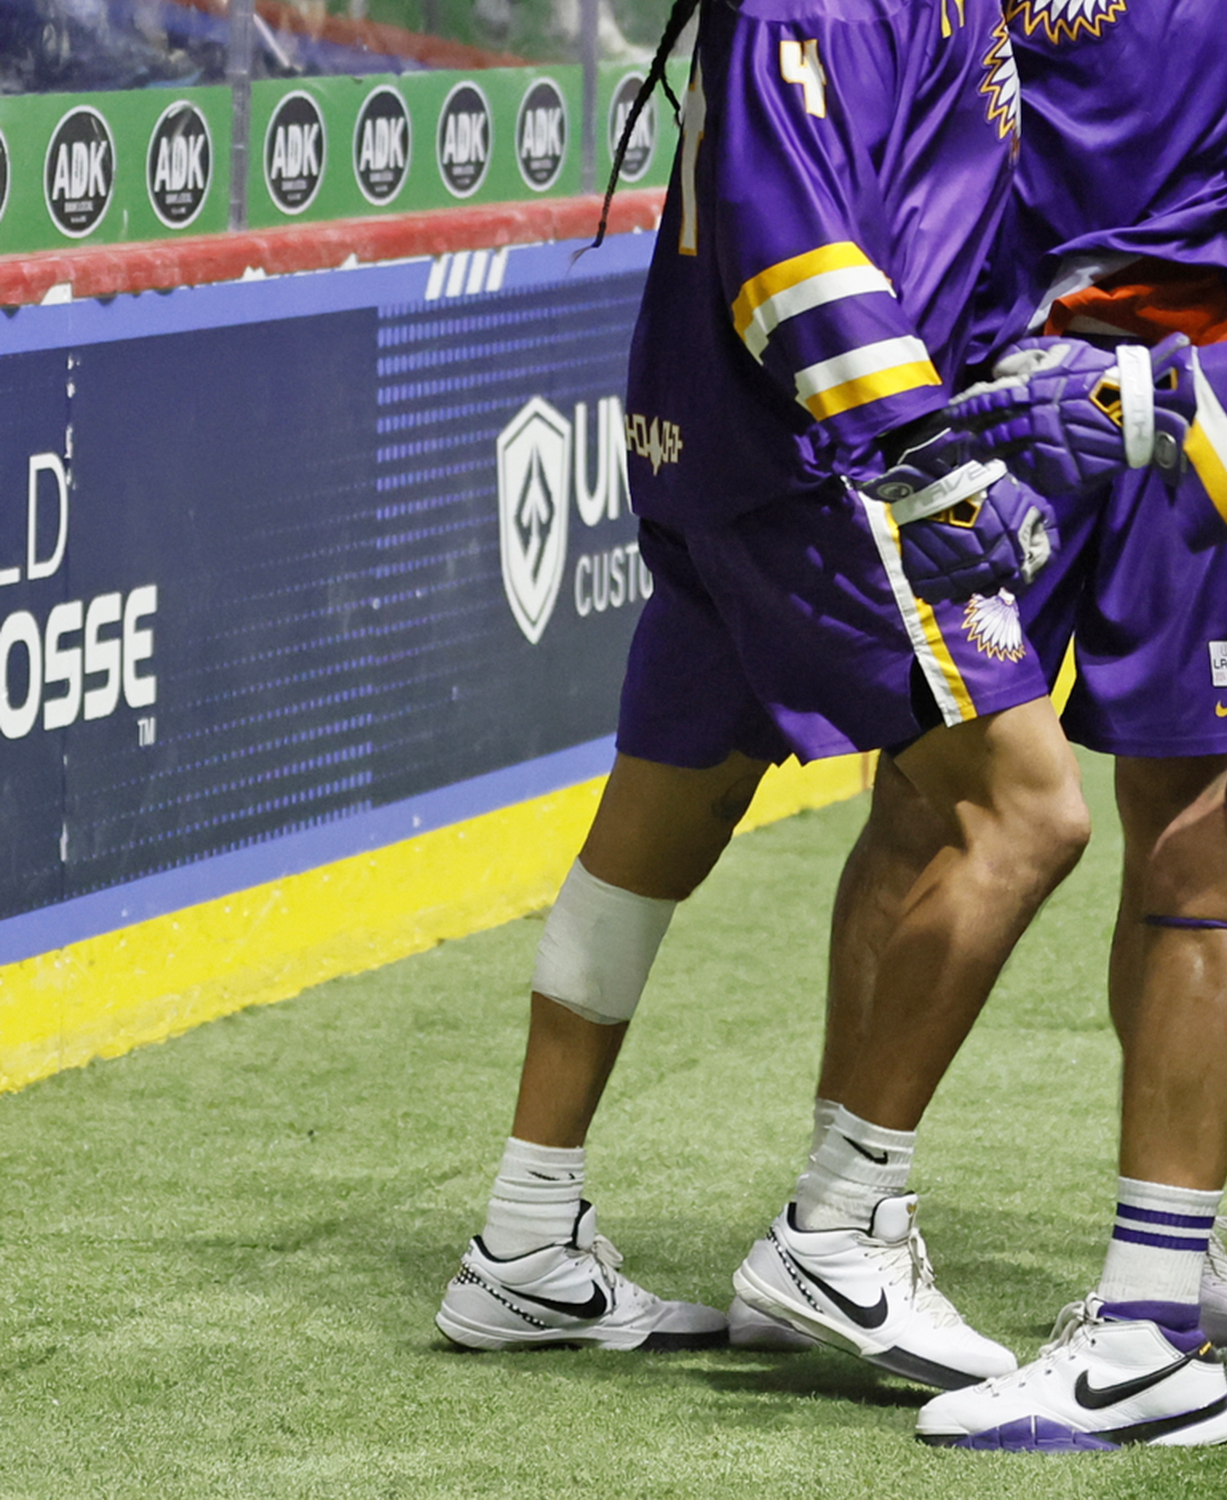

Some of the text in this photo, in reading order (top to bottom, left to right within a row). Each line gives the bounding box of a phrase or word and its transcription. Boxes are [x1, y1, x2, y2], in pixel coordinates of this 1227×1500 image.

[780, 39, 826, 119] 4
[271, 123, 320, 180] ADK
[359, 117, 405, 172] ADK
[443, 112, 486, 165] ADK
[521, 107, 562, 159] ADK
[52, 140, 107, 200] ADK
[154, 134, 206, 192] ADK
